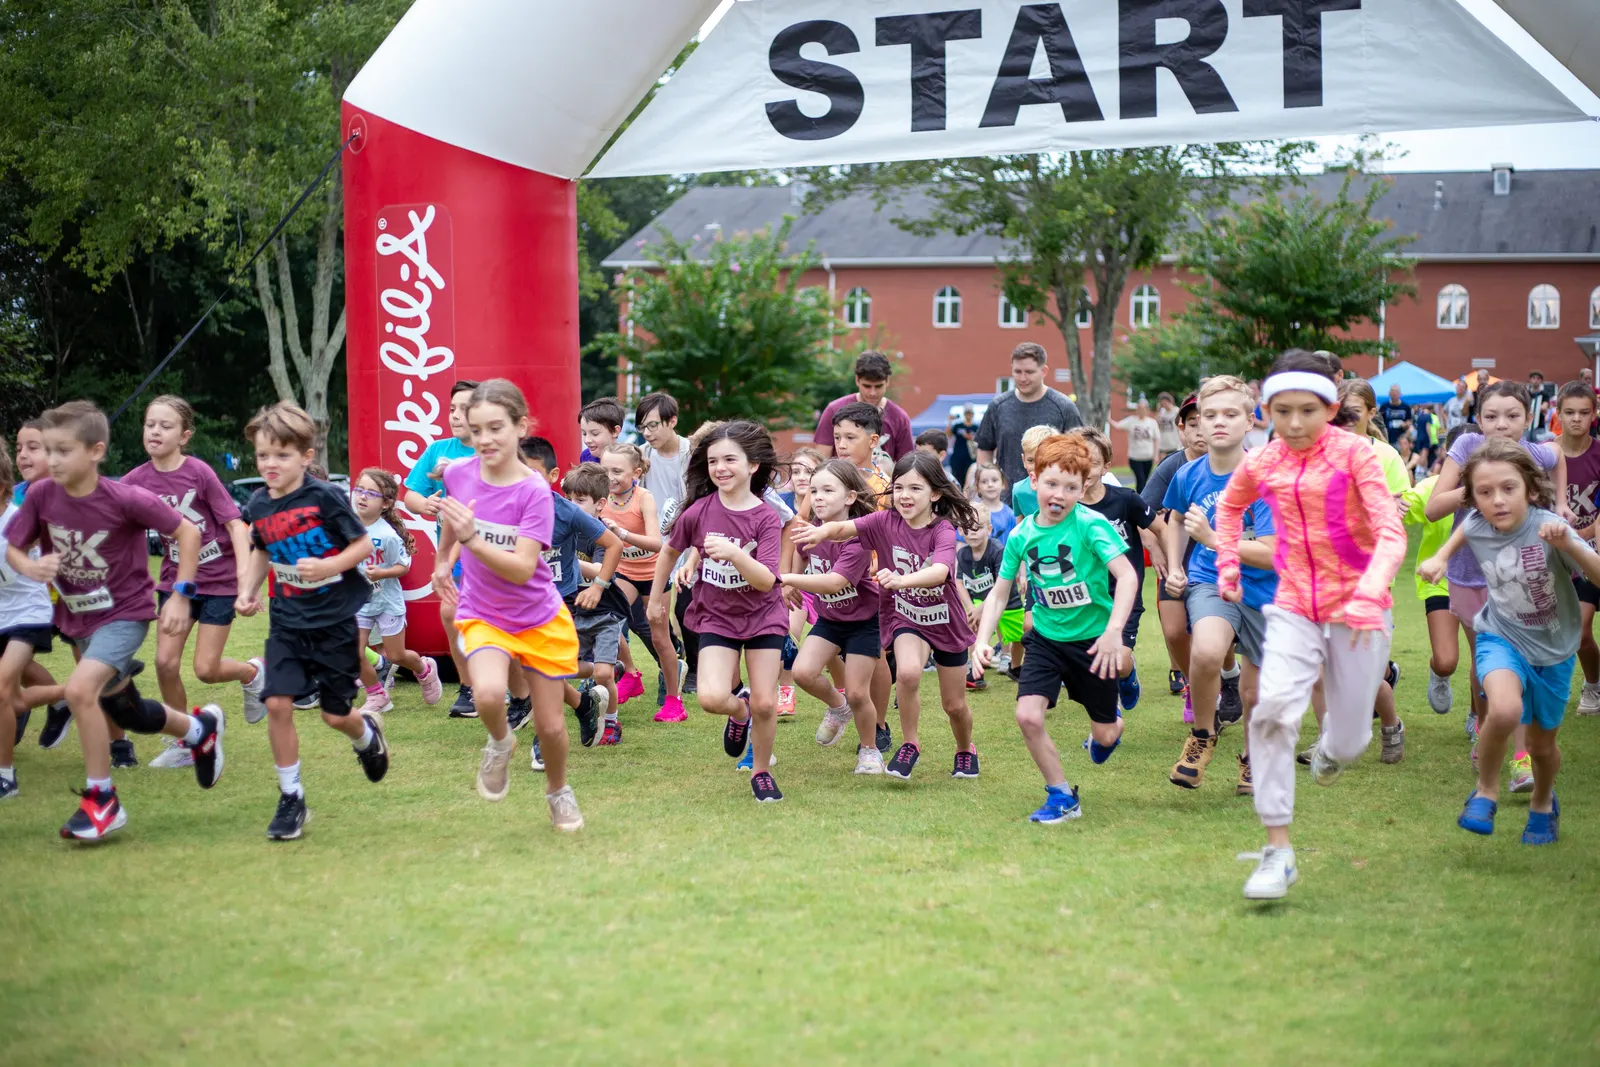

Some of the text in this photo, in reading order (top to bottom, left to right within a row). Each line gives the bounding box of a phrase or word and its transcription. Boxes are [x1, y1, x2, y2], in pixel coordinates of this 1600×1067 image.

[765, 0, 1362, 140] START
[376, 204, 454, 601] ck-fil-A
[255, 506, 323, 546] THREE
[484, 531, 518, 546] RUN
[199, 546, 219, 560] UN
[631, 549, 651, 558] RU
[60, 563, 109, 580] CKORY
[276, 571, 304, 584] FUN
[704, 568, 747, 585] FUN RU
[899, 584, 946, 597] KORY
[1048, 585, 1084, 605] 2019
[76, 594, 110, 608] RUN
[897, 602, 947, 622] FUN RUN
